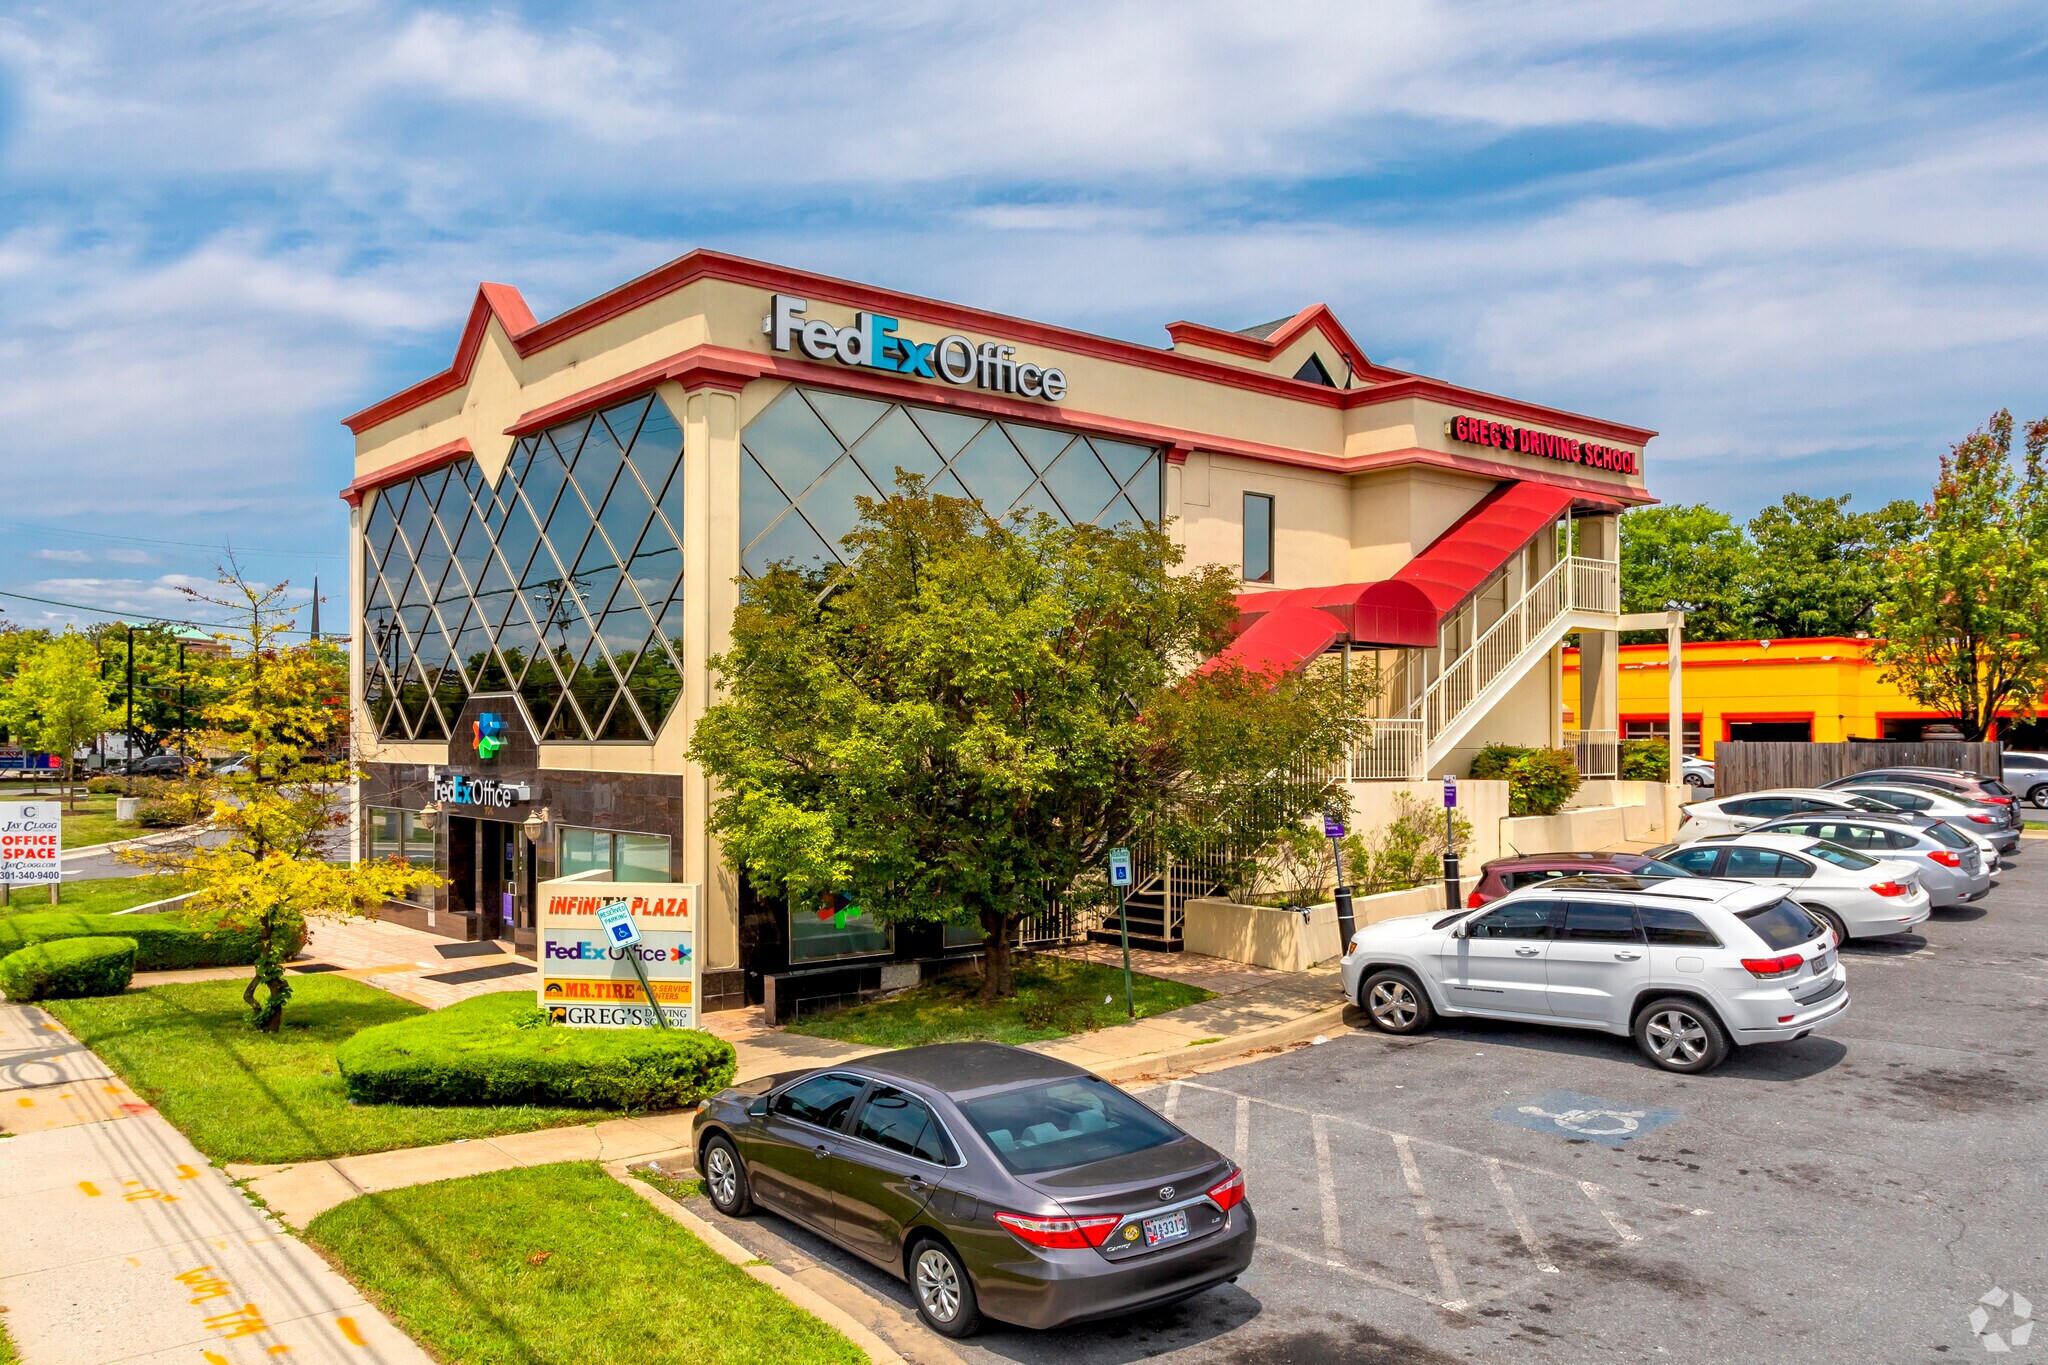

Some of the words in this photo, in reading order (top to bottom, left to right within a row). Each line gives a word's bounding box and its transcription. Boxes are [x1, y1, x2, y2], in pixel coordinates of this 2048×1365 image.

[771, 294, 935, 378] FedEx
[934, 335, 1067, 401] Office
[1453, 415, 1514, 450] GREG'S
[1517, 428, 1581, 463] DRIVING
[1584, 443, 1639, 475] SCHOOL
[434, 775, 472, 804] FedEx
[472, 779, 511, 808] Office
[2, 821, 22, 832] JAY
[24, 821, 57, 832] CLOGG
[2, 835, 57, 846] OFFICE
[3, 848, 56, 859] SPACE
[0, 871, 59, 880] 301-340-9400
[599, 905, 626, 918] RESERVED
[631, 896, 688, 917] PLAZA
[604, 912, 628, 924] PARKING
[545, 940, 606, 960] FedEx
[608, 944, 666, 961] Ofice
[658, 985, 690, 993] SERVICE
[568, 1008, 642, 1026] GREG'S
